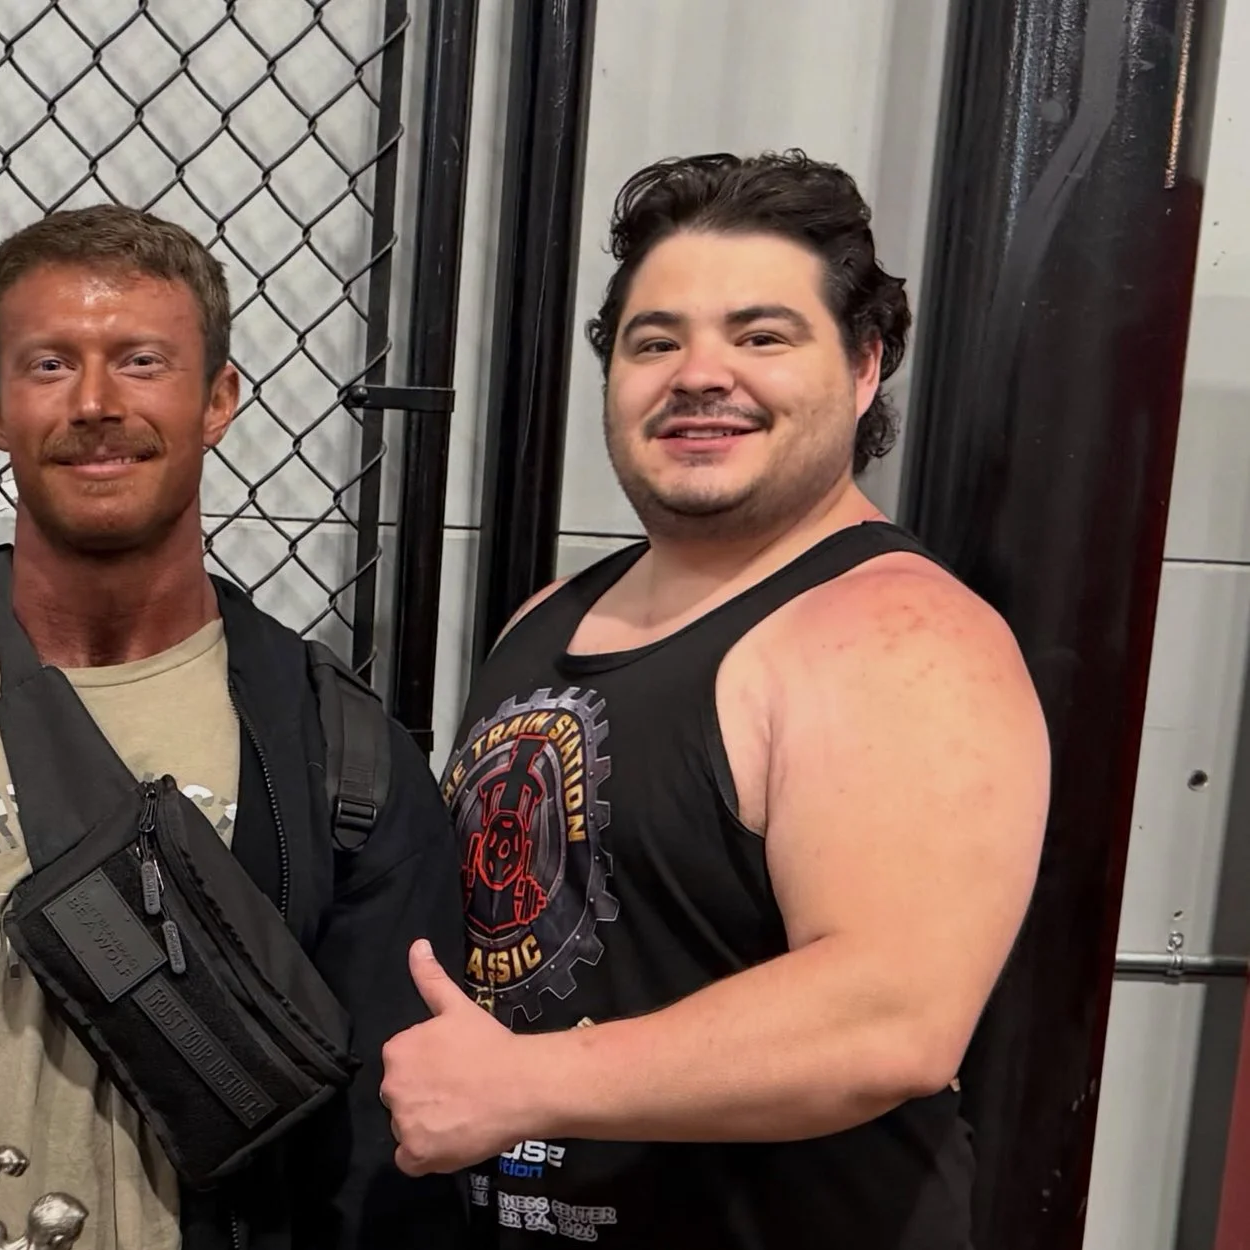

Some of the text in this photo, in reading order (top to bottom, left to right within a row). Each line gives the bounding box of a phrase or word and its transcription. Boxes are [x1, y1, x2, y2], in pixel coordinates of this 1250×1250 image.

[443, 711, 586, 842] HE TRAIN STATION
[66, 896, 88, 920] BE
[93, 931, 134, 982] WOLF
[466, 936, 542, 983] ASSIC
[142, 984, 189, 1034] TRUST
[176, 1023, 216, 1065] YOUR
[552, 1199, 619, 1225] CENTER
